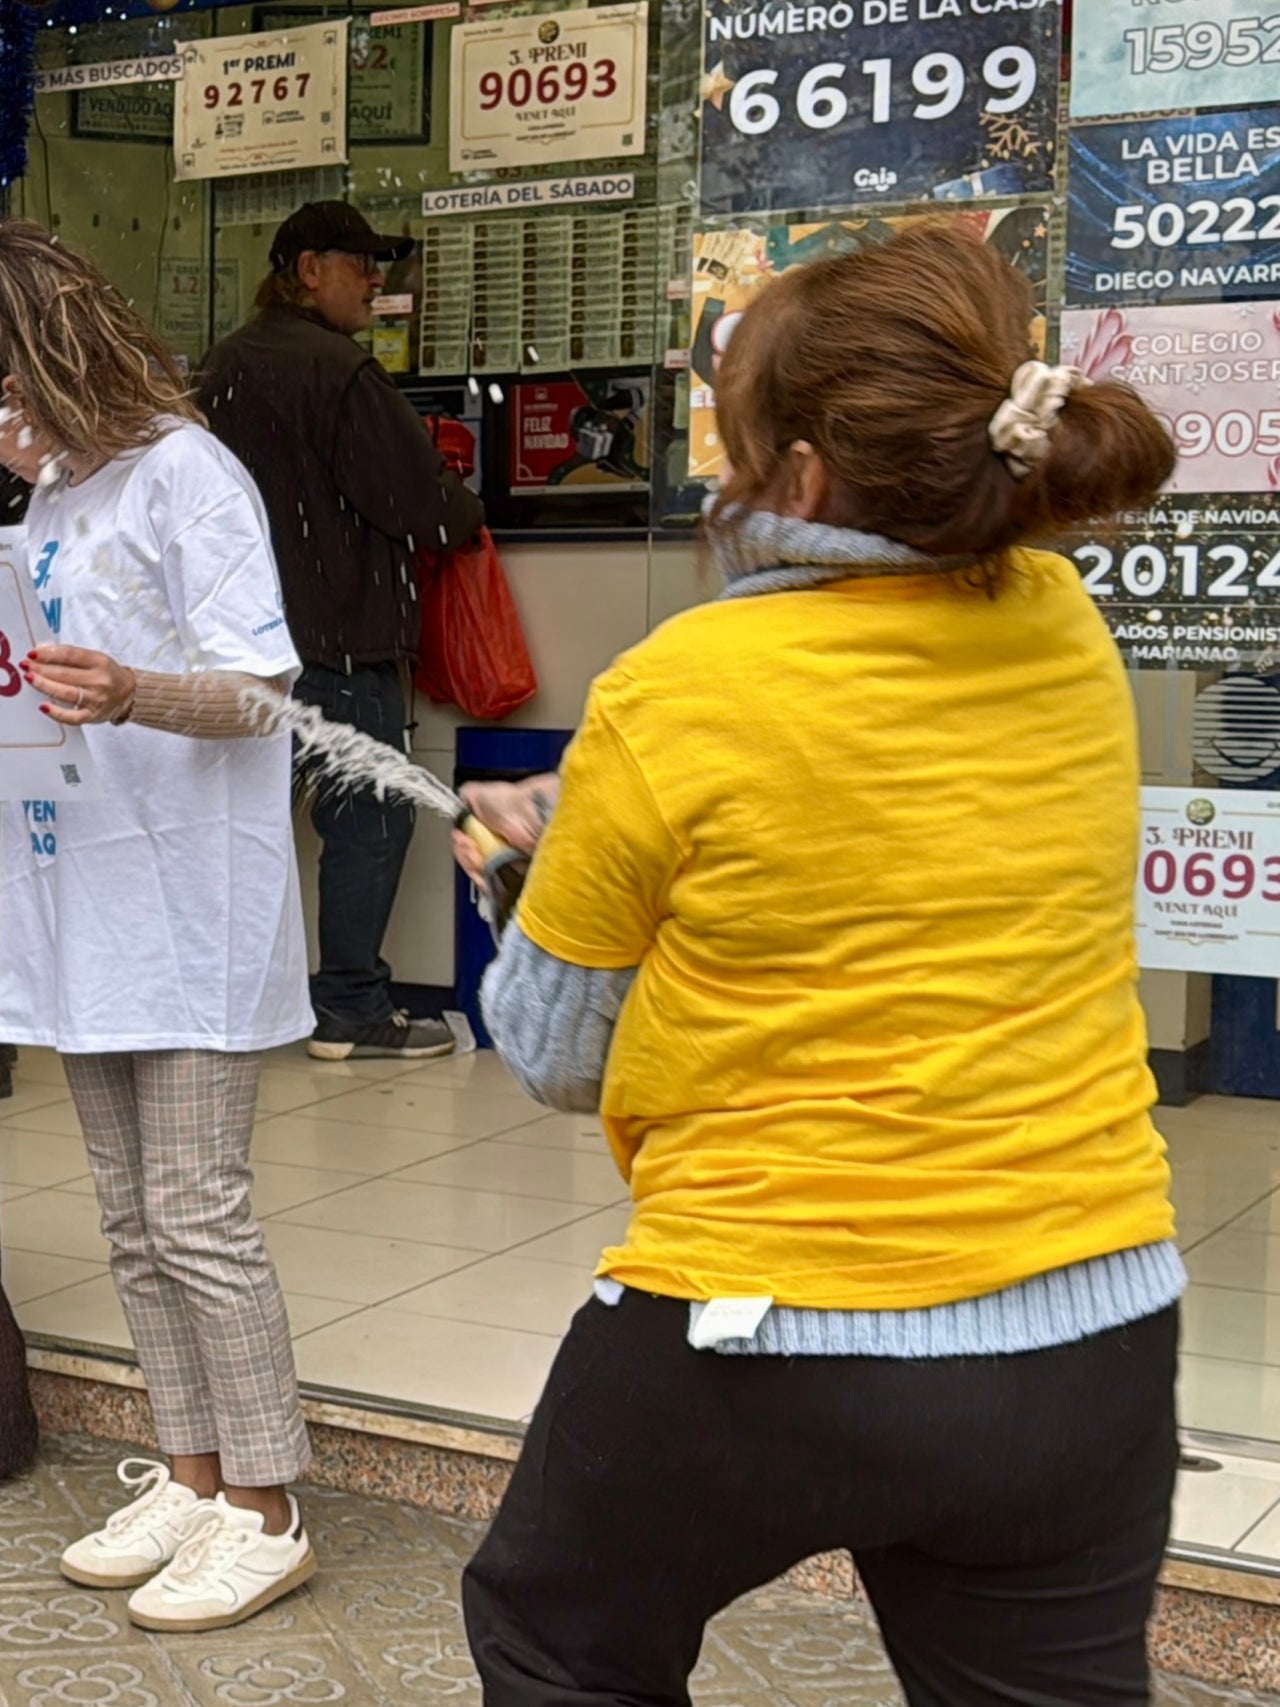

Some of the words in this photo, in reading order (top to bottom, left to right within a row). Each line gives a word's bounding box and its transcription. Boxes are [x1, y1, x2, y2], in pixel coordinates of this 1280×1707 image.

[863, 0, 908, 25] DE
[918, 0, 961, 20] LA
[244, 52, 296, 73] PREMI
[528, 42, 587, 64] PREMI
[89, 58, 181, 83] BUSCADOS
[204, 72, 311, 109] 92767
[479, 59, 617, 110] 90693
[729, 46, 1037, 135] 66199
[1121, 137, 1159, 160] LA
[1165, 131, 1240, 155] VIDA
[853, 167, 897, 188] Gaia
[1147, 152, 1260, 185] BELLA
[424, 186, 502, 211] LOTERÍA
[507, 186, 543, 204] DEL
[550, 178, 632, 199] SÁBADO
[1095, 269, 1174, 294] DIEGO
[1131, 331, 1263, 356] COLEGIO
[1110, 362, 1187, 385] SANT
[1156, 408, 1280, 459] 905
[1173, 510, 1200, 524] DE
[1109, 625, 1168, 640] ADOS
[1132, 646, 1238, 662] MARIANAO
[1172, 827, 1254, 850] PREMI
